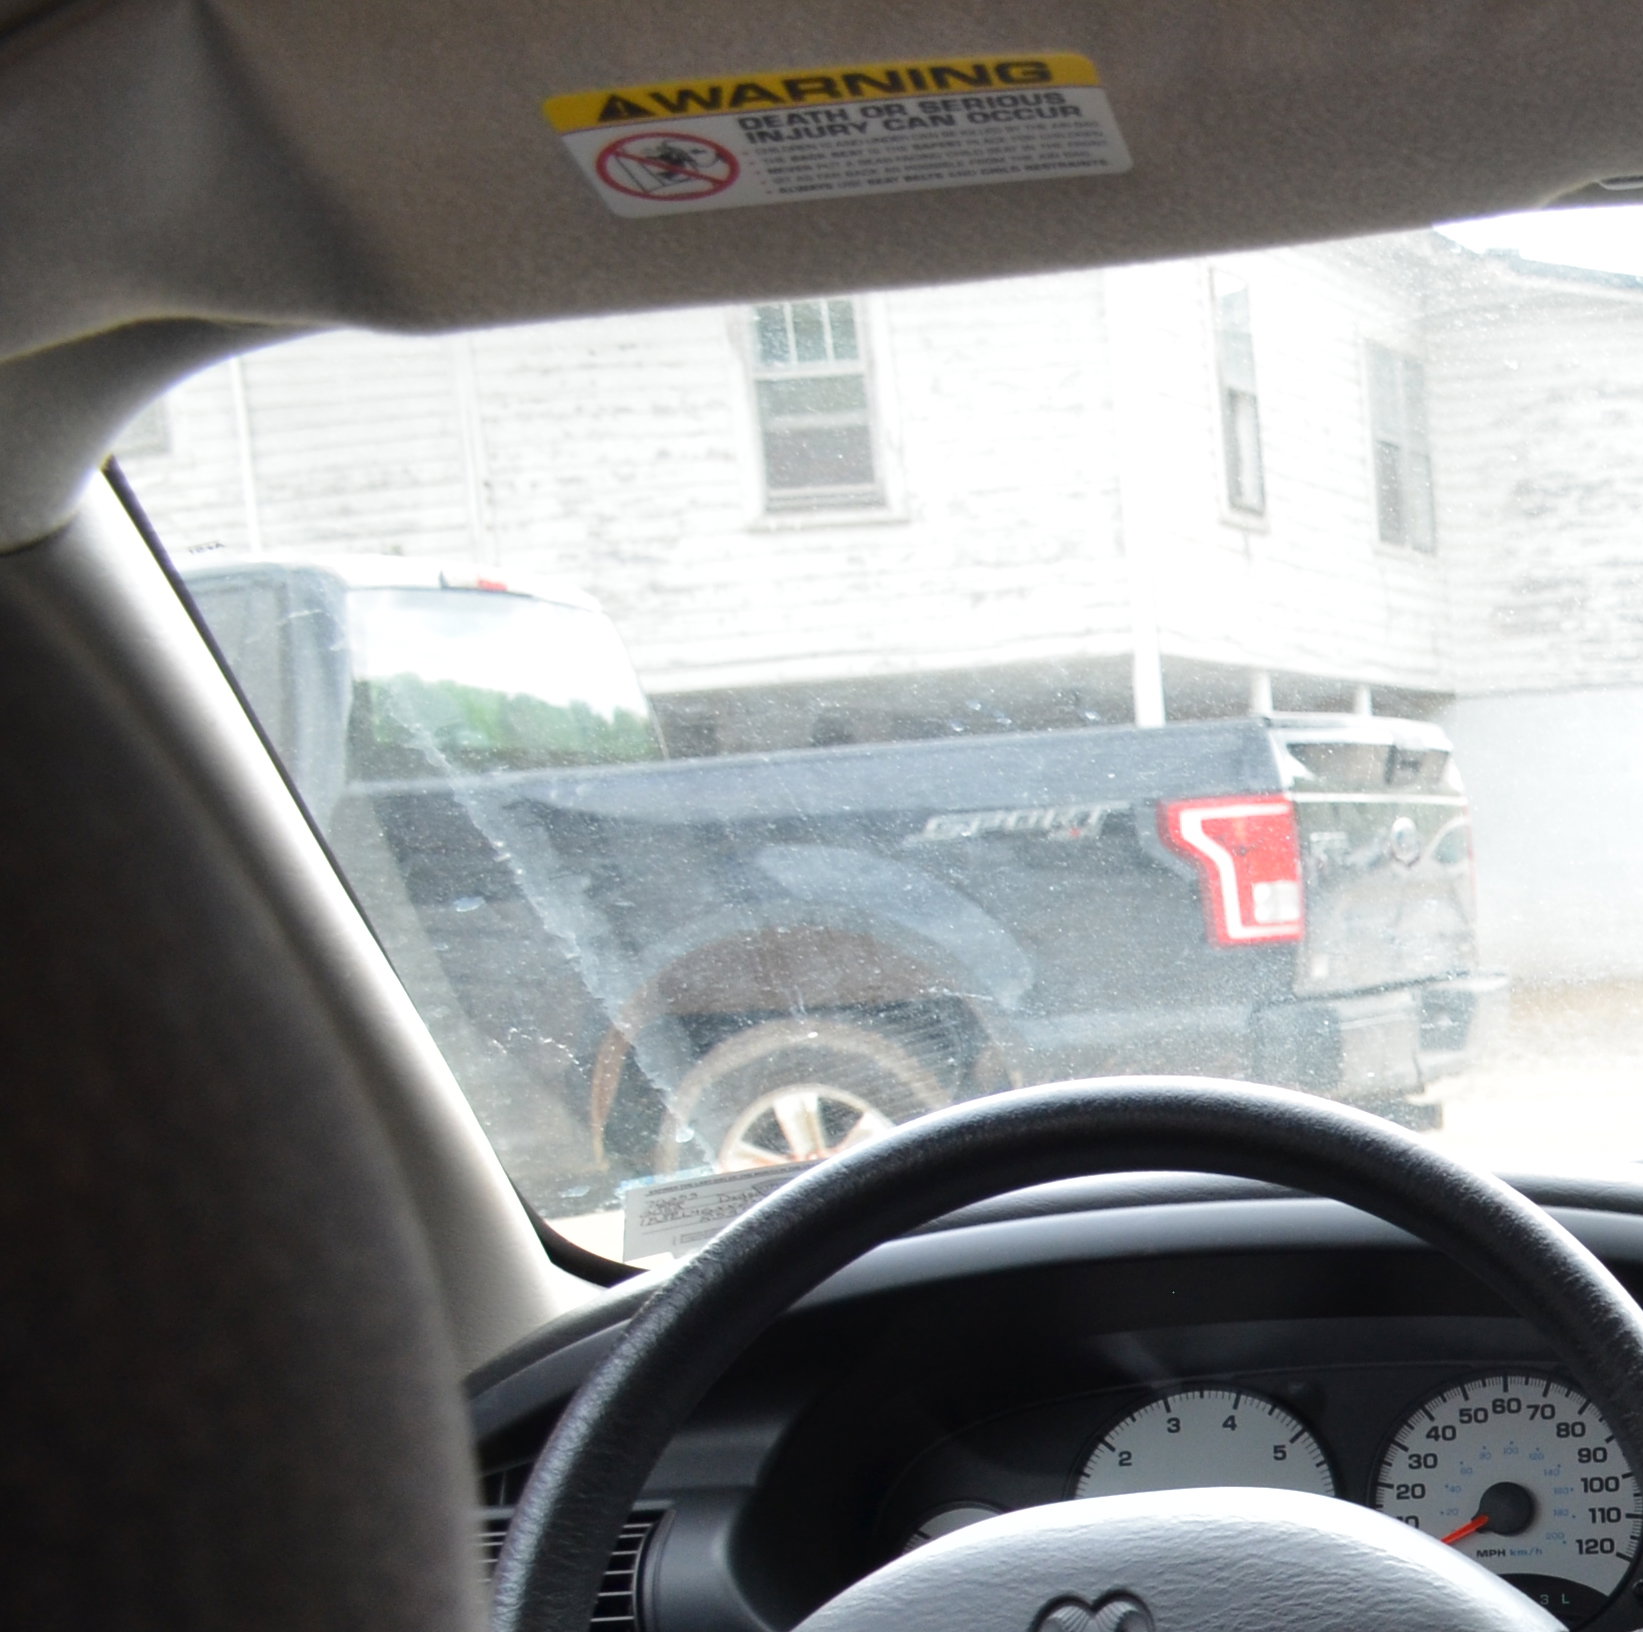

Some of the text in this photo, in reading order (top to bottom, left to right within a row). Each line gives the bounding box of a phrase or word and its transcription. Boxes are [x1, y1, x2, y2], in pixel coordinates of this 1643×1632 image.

[650, 59, 1055, 114] WARNING
[737, 92, 1068, 132] DEATH OR SERIOUS
[745, 121, 869, 145] INJURY
[883, 112, 957, 132] CAN
[966, 105, 1083, 125] OCCUR
[1492, 1398, 1522, 1415] 60
[1525, 1403, 1556, 1421] 70
[1222, 1415, 1237, 1431] 4
[1458, 1407, 1489, 1424] 50
[1166, 1417, 1181, 1434] 3
[1425, 1425, 1457, 1442] 40
[1555, 1421, 1586, 1439] 80
[1118, 1451, 1132, 1467] 2
[1273, 1445, 1287, 1461] 5
[1408, 1453, 1439, 1470] 30
[1577, 1447, 1608, 1464] 90
[1396, 1483, 1426, 1500] 20
[1580, 1476, 1620, 1494] 100
[1588, 1507, 1622, 1524] 110
[1476, 1547, 1543, 1558] MPH km/h
[1575, 1538, 1615, 1555] 120
